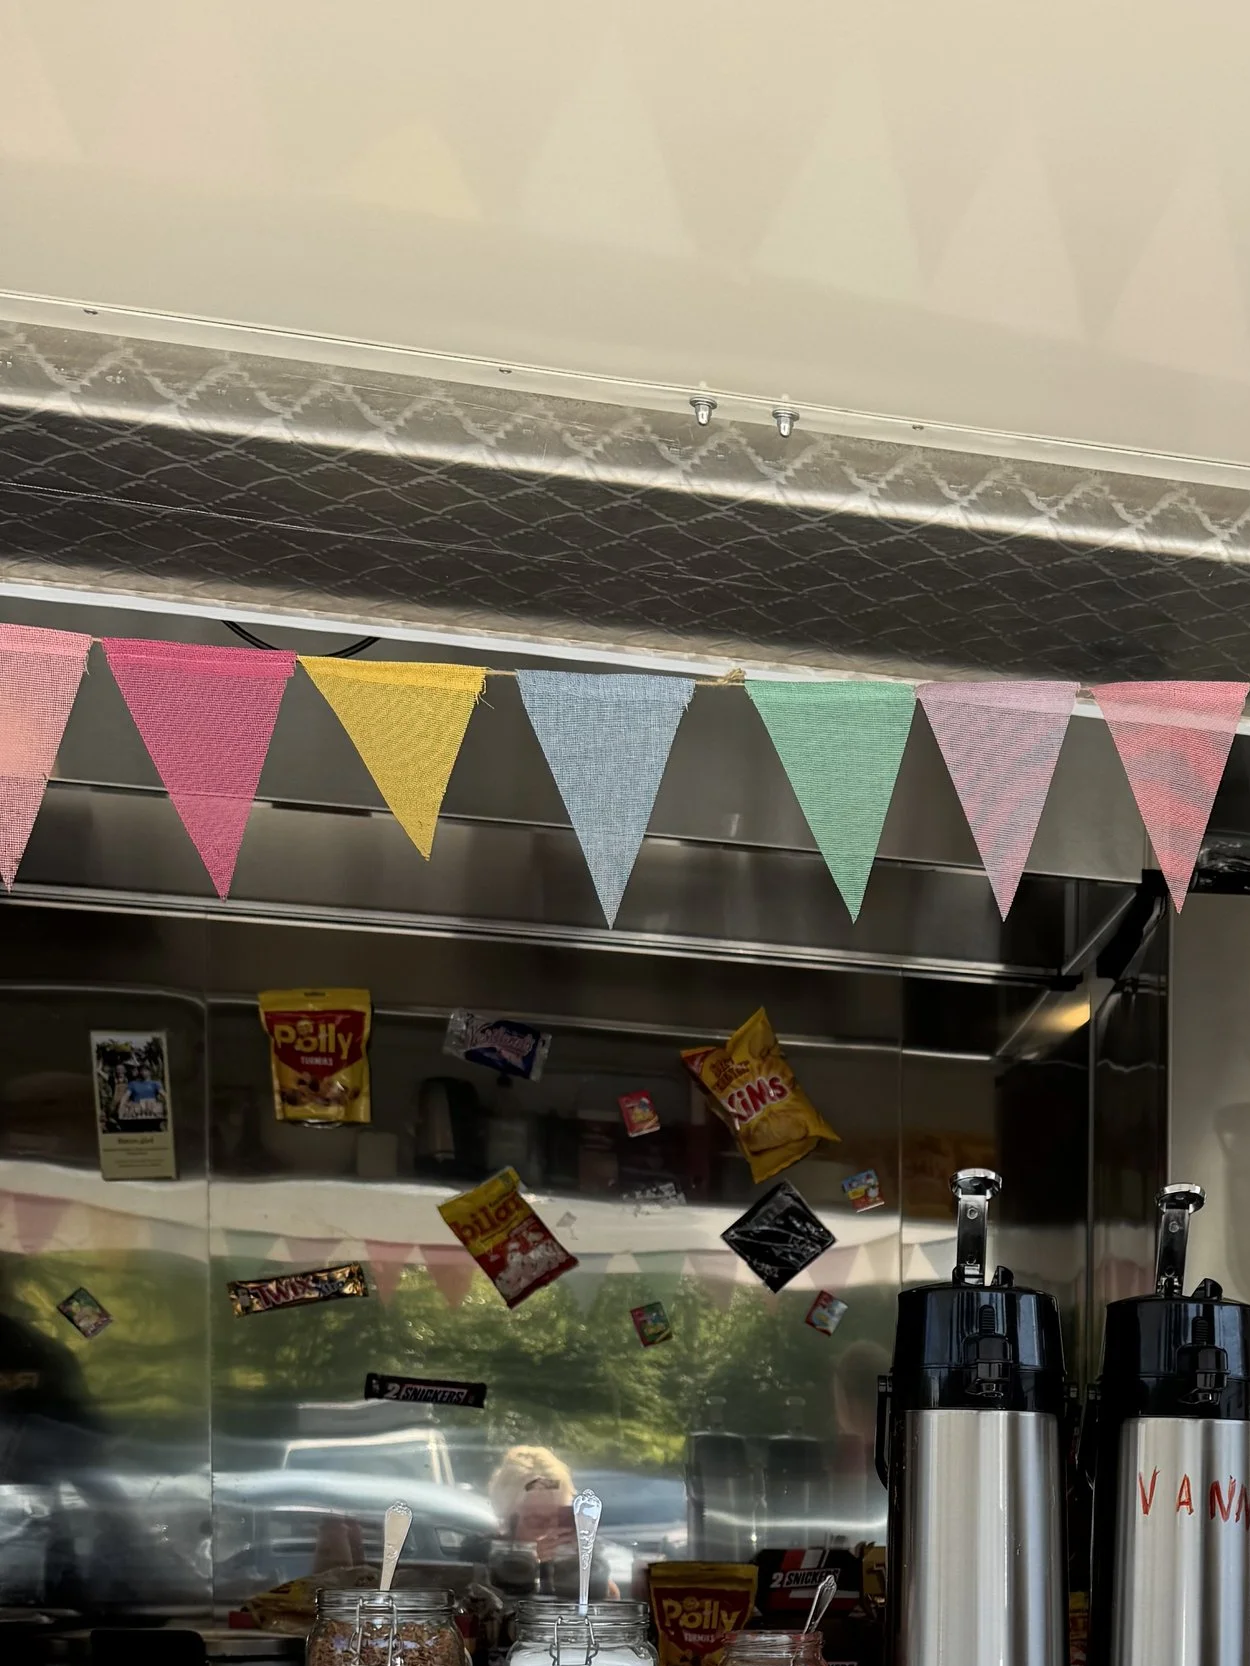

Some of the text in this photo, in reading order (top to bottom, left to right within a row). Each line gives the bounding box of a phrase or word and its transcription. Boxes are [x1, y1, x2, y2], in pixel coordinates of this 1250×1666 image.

[273, 1021, 353, 1061] Polly
[383, 1382, 401, 1399] 2
[770, 1572, 785, 1589] 2
[662, 1596, 743, 1634] Polly
